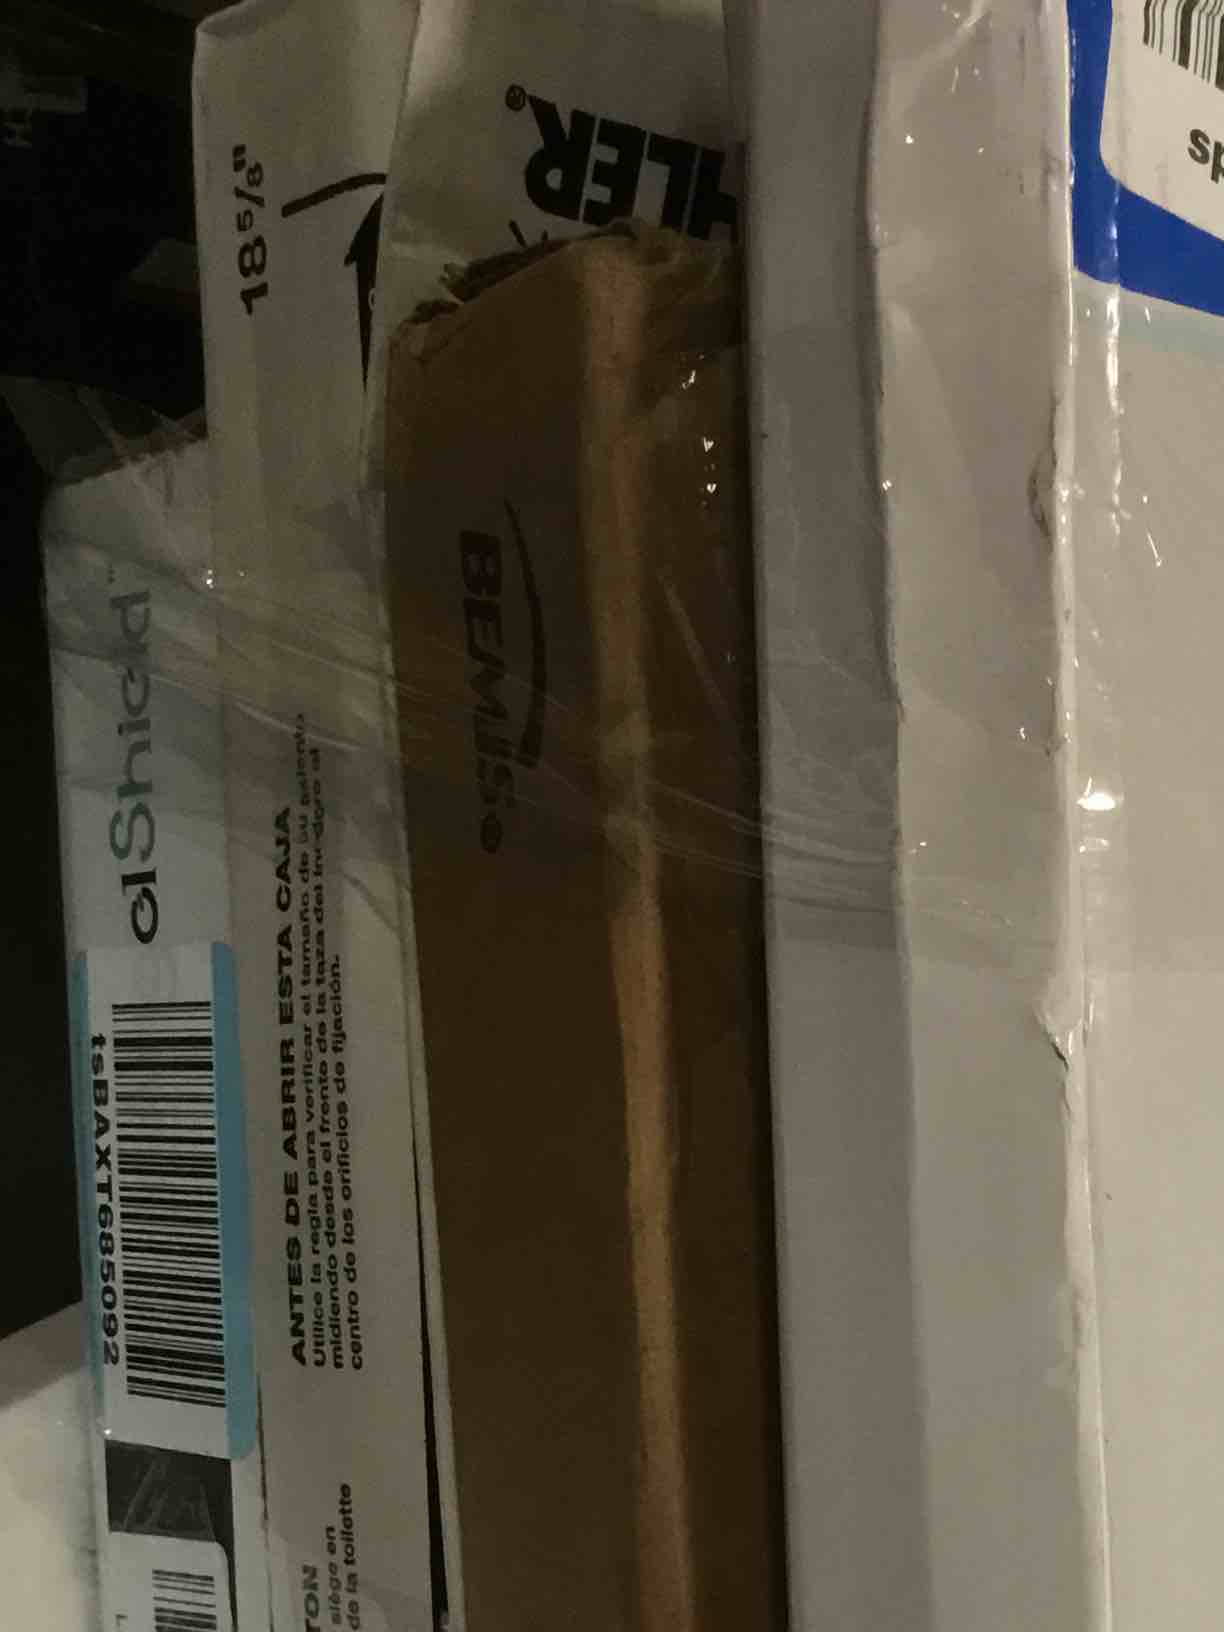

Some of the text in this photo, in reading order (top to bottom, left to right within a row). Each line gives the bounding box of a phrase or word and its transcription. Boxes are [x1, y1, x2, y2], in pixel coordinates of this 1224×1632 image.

[298, 852, 310, 883] de
[300, 995, 312, 1016] el
[314, 992, 327, 1015] la
[315, 1021, 328, 1054] de
[274, 808, 307, 1367] ANTES DE ABRIR ESTA CAJA
[302, 1023, 316, 1123] verificar
[332, 1060, 347, 1095] de
[305, 1130, 319, 1186] para
[319, 1141, 332, 1163] el
[336, 1100, 352, 1201] orificios
[92, 1033, 120, 1366] tsBAXT685092
[341, 1207, 355, 1245] los
[343, 1251, 357, 1284] de
[310, 1291, 327, 1368] Utilice
[326, 1254, 344, 1370] midiendo
[346, 1290, 363, 1371] centro
[324, 1526, 337, 1555] en
[338, 1483, 357, 1567] toilette
[344, 1572, 359, 1593] la
[344, 1600, 361, 1631] de
